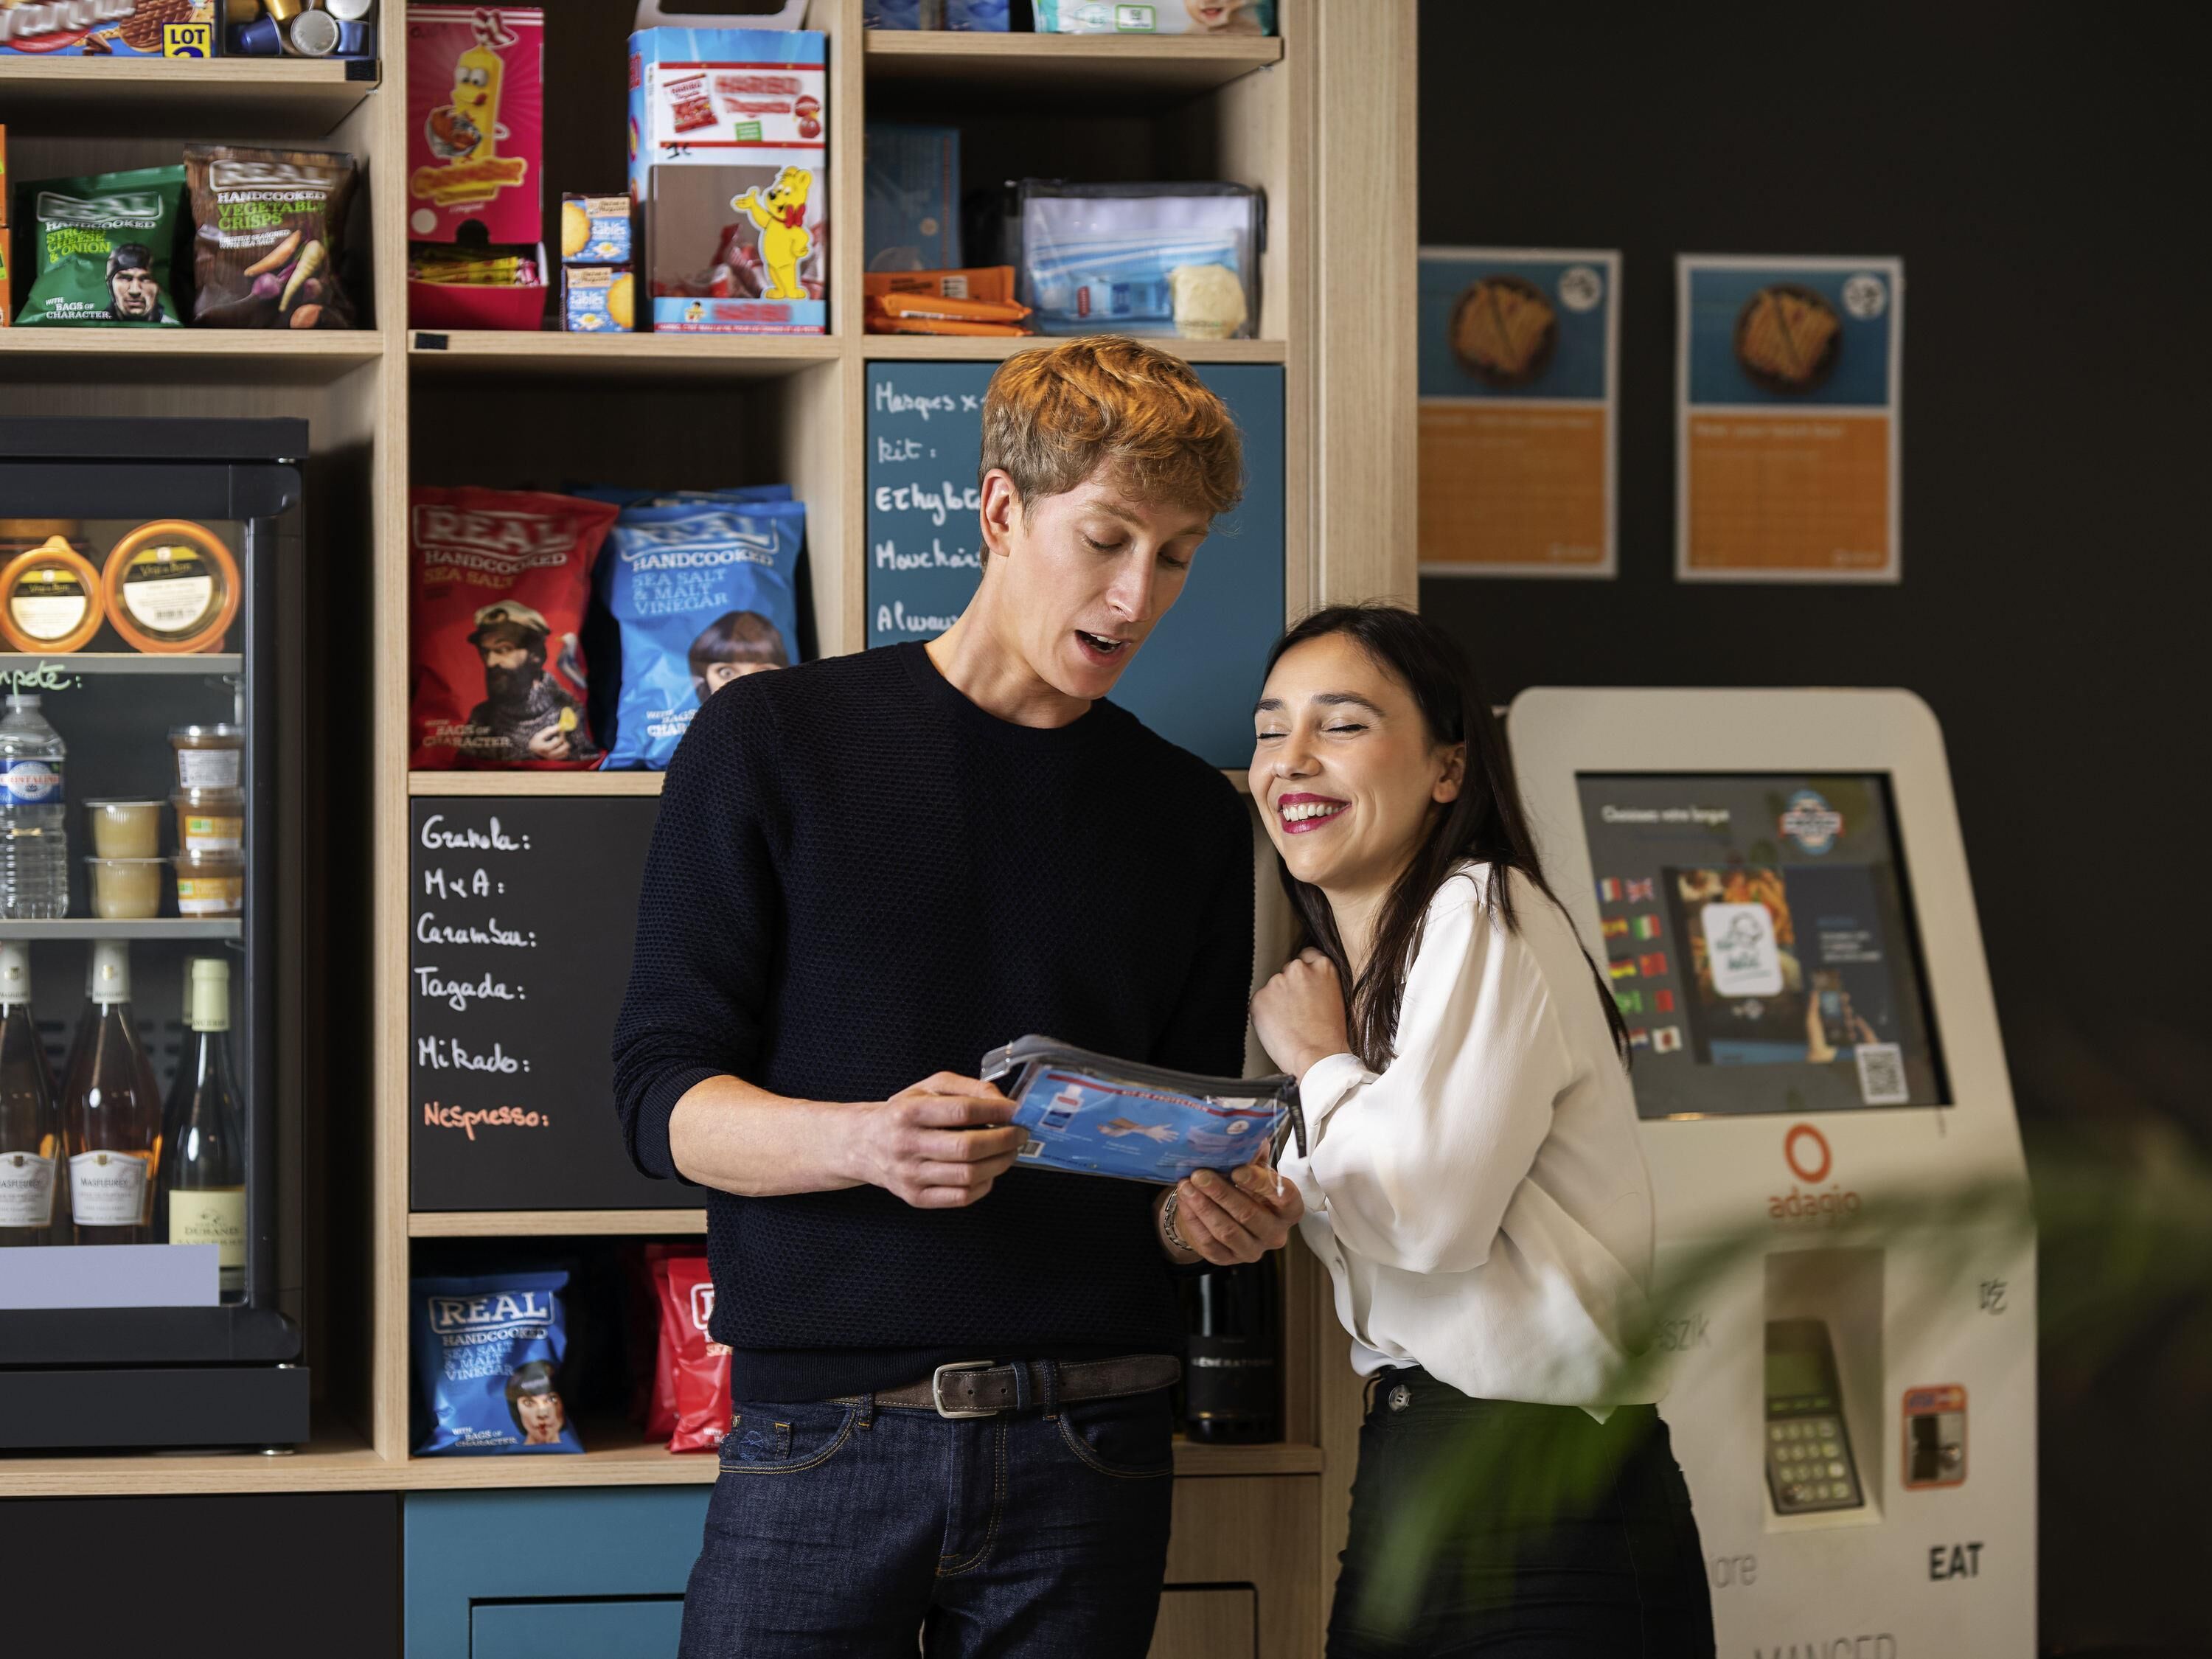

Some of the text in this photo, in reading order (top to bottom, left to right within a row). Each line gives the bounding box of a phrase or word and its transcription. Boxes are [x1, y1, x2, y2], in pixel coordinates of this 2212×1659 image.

[170, 28, 206, 45] LOT
[218, 190, 327, 204] HANDCOOKED
[218, 201, 327, 218] VEGETABLE
[218, 212, 283, 231] CRISPS
[61, 242, 111, 257] ONION
[46, 296, 64, 305] WITH
[56, 302, 83, 311] BAGS
[424, 550, 568, 575] HANDCOOKED
[633, 549, 774, 571] HANDCOOKED
[422, 566, 516, 590] SEA SALT
[632, 568, 726, 587] SEA SALT
[655, 582, 713, 600] MALT
[634, 591, 728, 616] VINEGAR
[424, 1102, 549, 1141] Nespresso:
[439, 1292, 549, 1326] REAL
[443, 1327, 549, 1346] HANDCOOKED
[476, 1341, 513, 1356] SALT
[460, 1354, 502, 1368] MALT
[445, 1363, 515, 1381] VINEGAR
[1928, 1542, 1984, 1582] EAT
